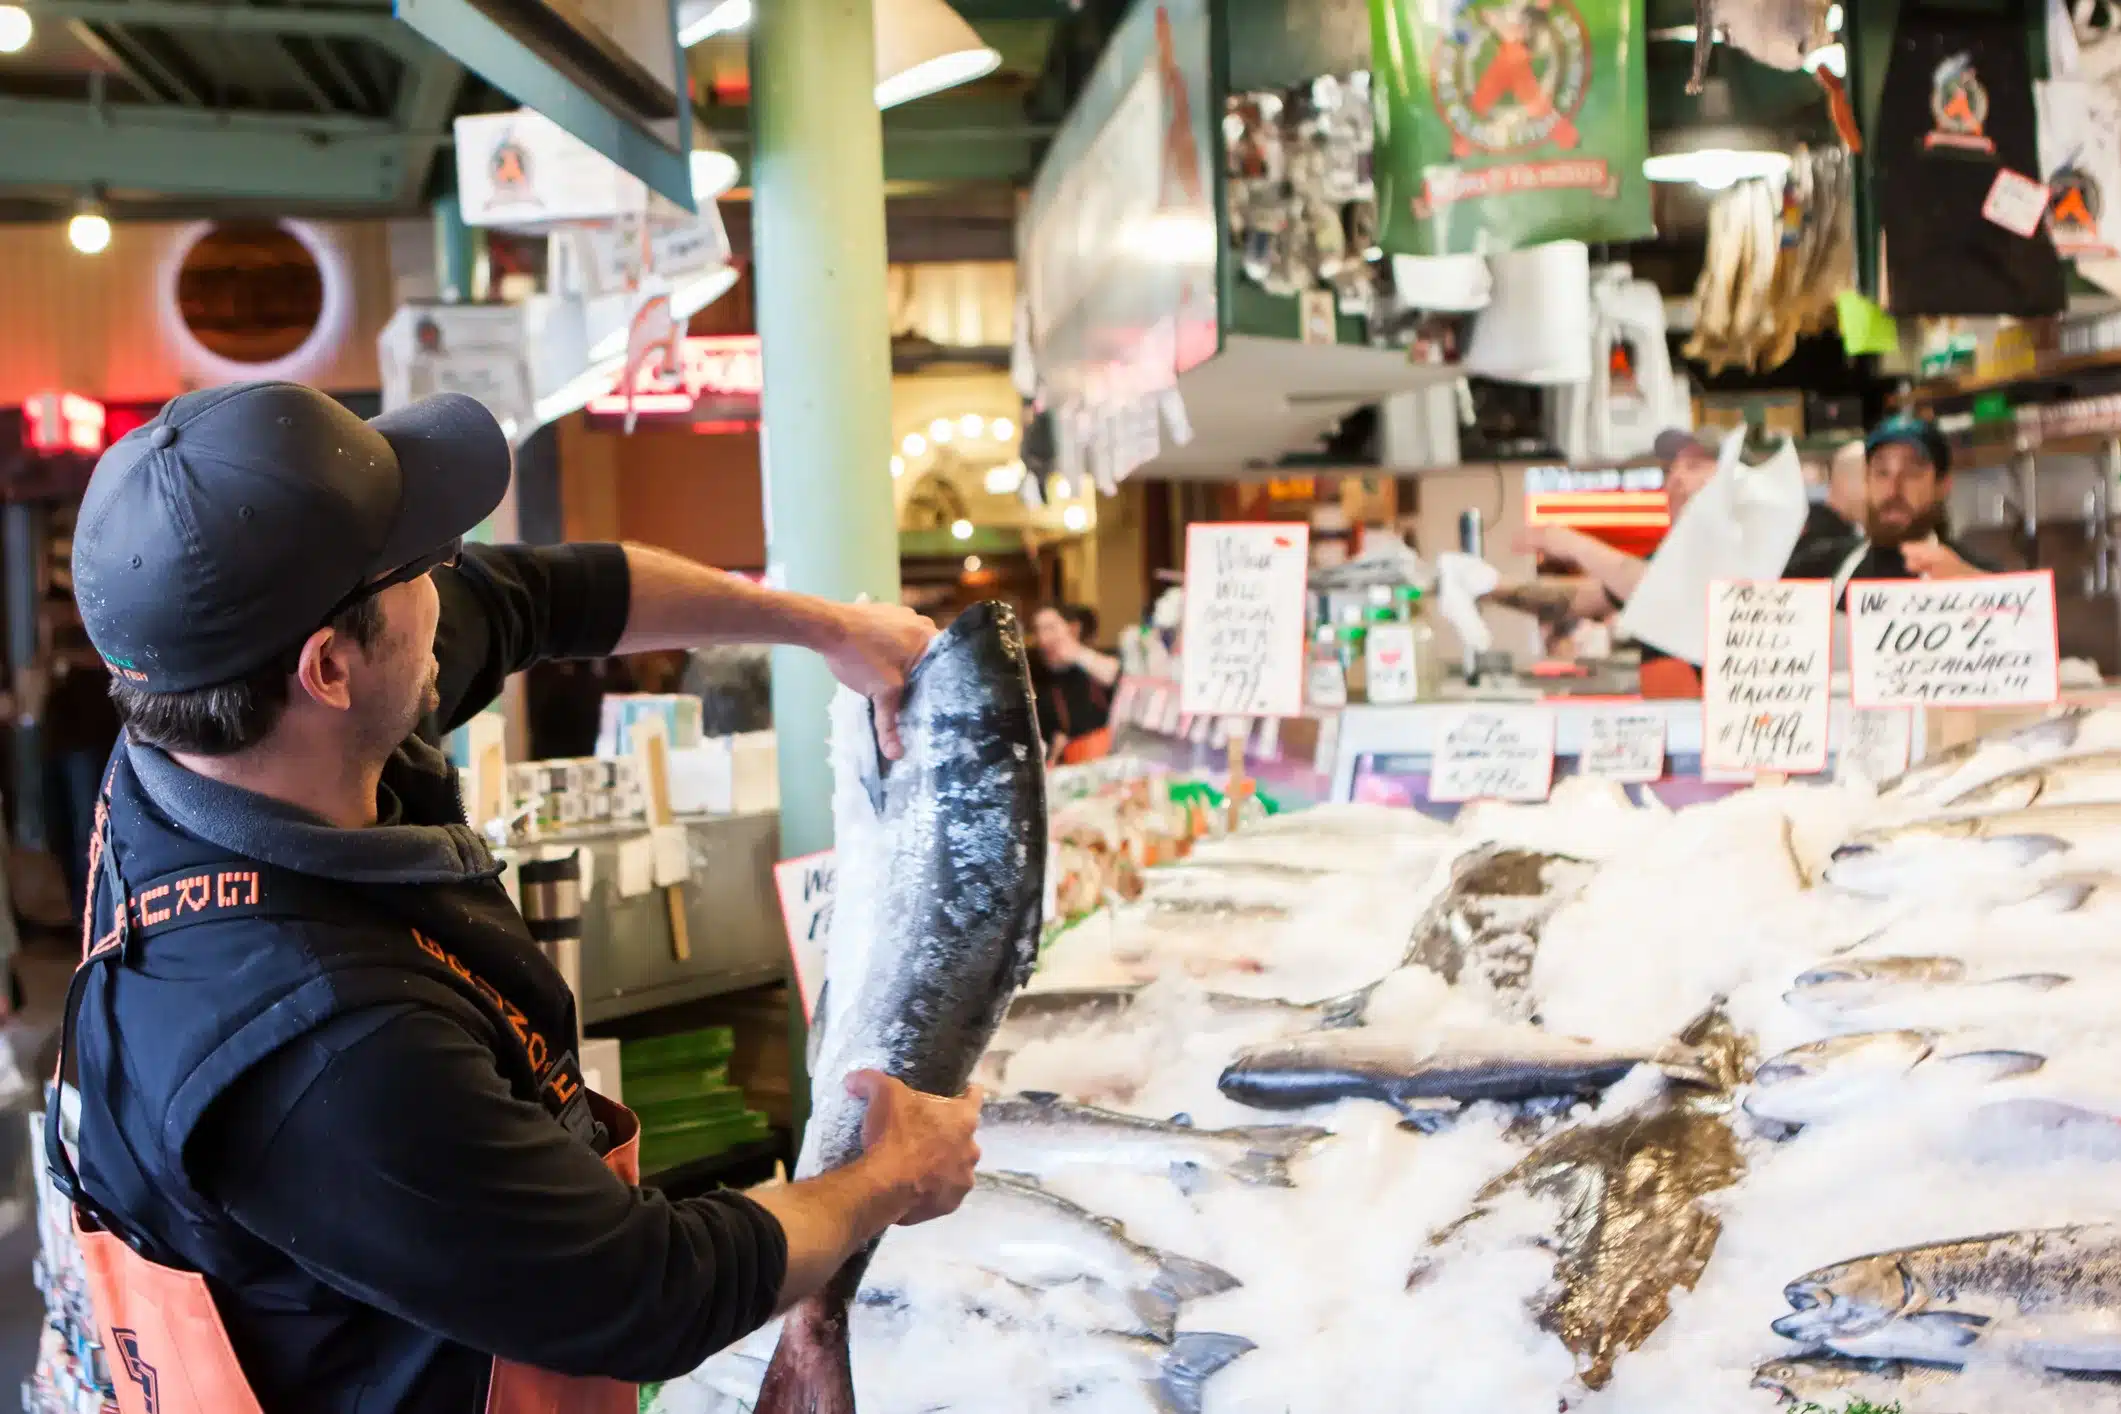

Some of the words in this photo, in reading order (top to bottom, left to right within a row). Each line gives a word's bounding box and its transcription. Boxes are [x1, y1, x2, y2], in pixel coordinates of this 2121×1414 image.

[1725, 629, 1791, 650] WILD
[1874, 616, 1996, 654] 100%
[1720, 650, 1817, 680] ALASKAN
